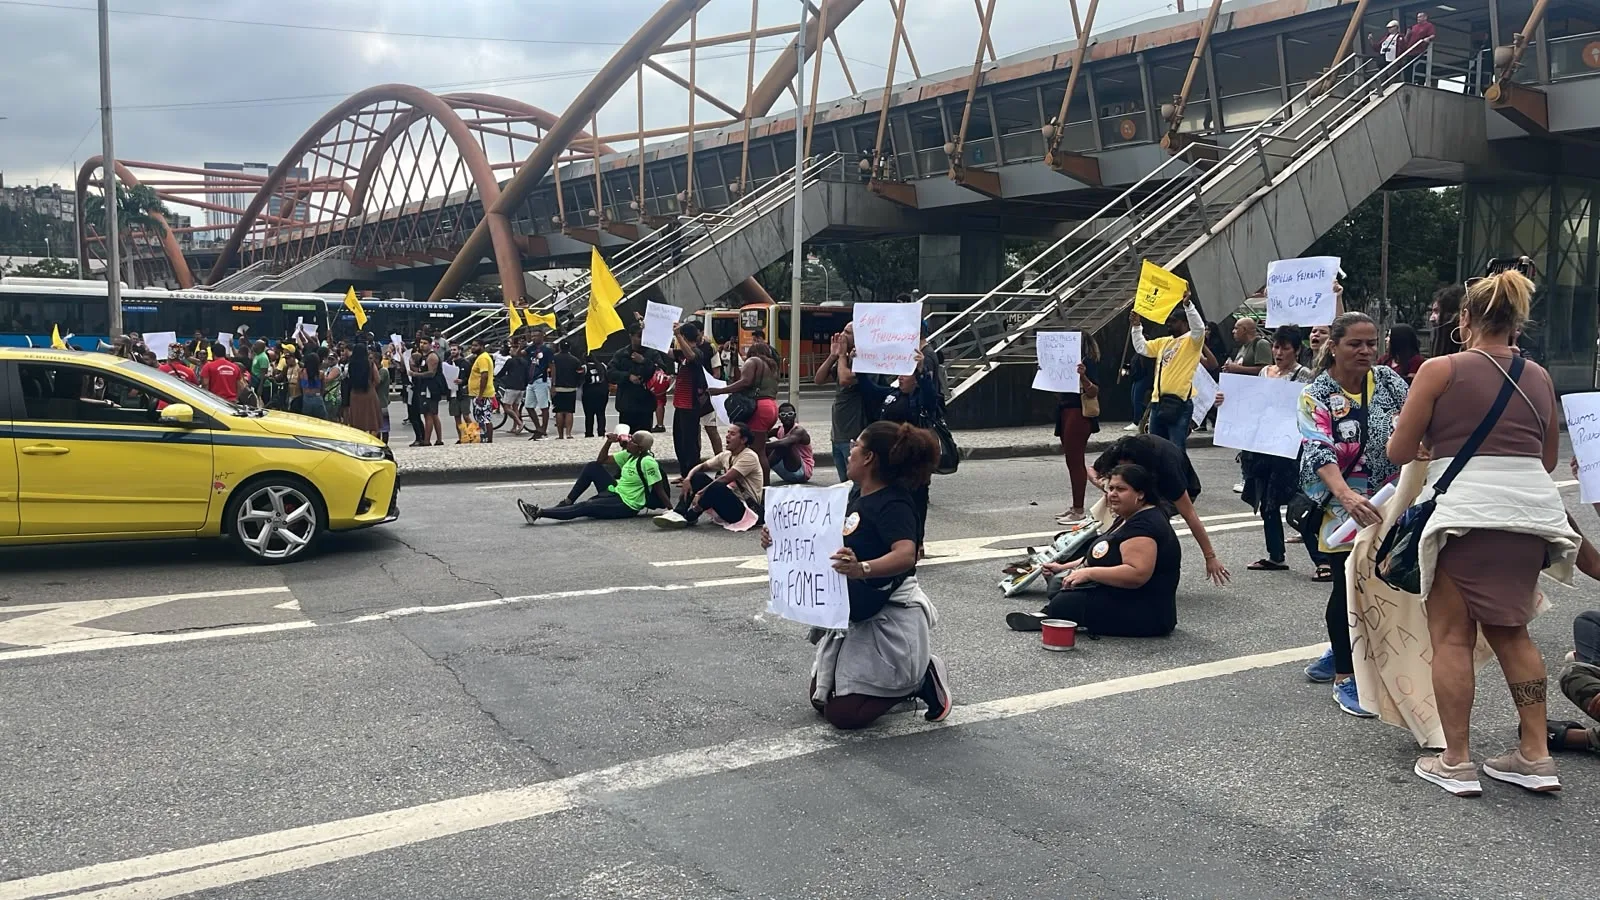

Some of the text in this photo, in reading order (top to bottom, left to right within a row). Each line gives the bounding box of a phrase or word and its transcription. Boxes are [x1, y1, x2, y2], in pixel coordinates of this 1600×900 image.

[1296, 268, 1325, 282] FEIRANTE
[183, 294, 256, 302] CONDICIONADO
[1288, 293, 1322, 309] COME?
[772, 499, 819, 531] PREFEITO
[822, 503, 832, 527] A
[772, 534, 816, 563] LAPA ESTÁ
